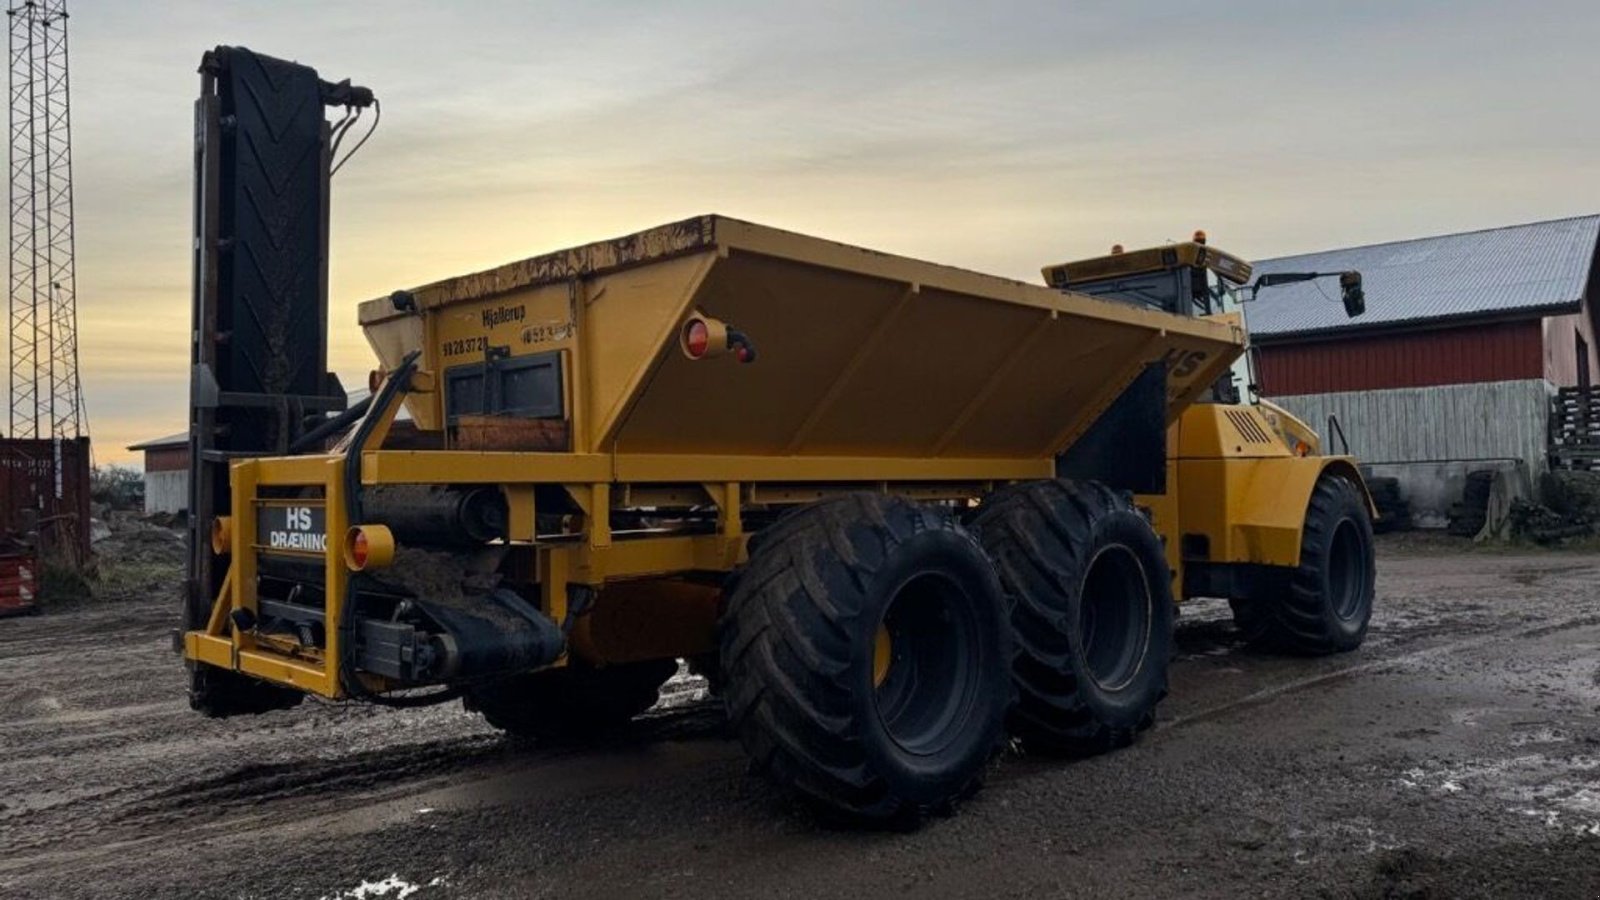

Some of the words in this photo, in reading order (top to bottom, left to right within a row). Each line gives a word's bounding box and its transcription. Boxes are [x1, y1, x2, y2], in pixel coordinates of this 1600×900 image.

[482, 304, 526, 329] Hjallerup
[1161, 347, 1207, 377] HS
[286, 507, 312, 531] HS
